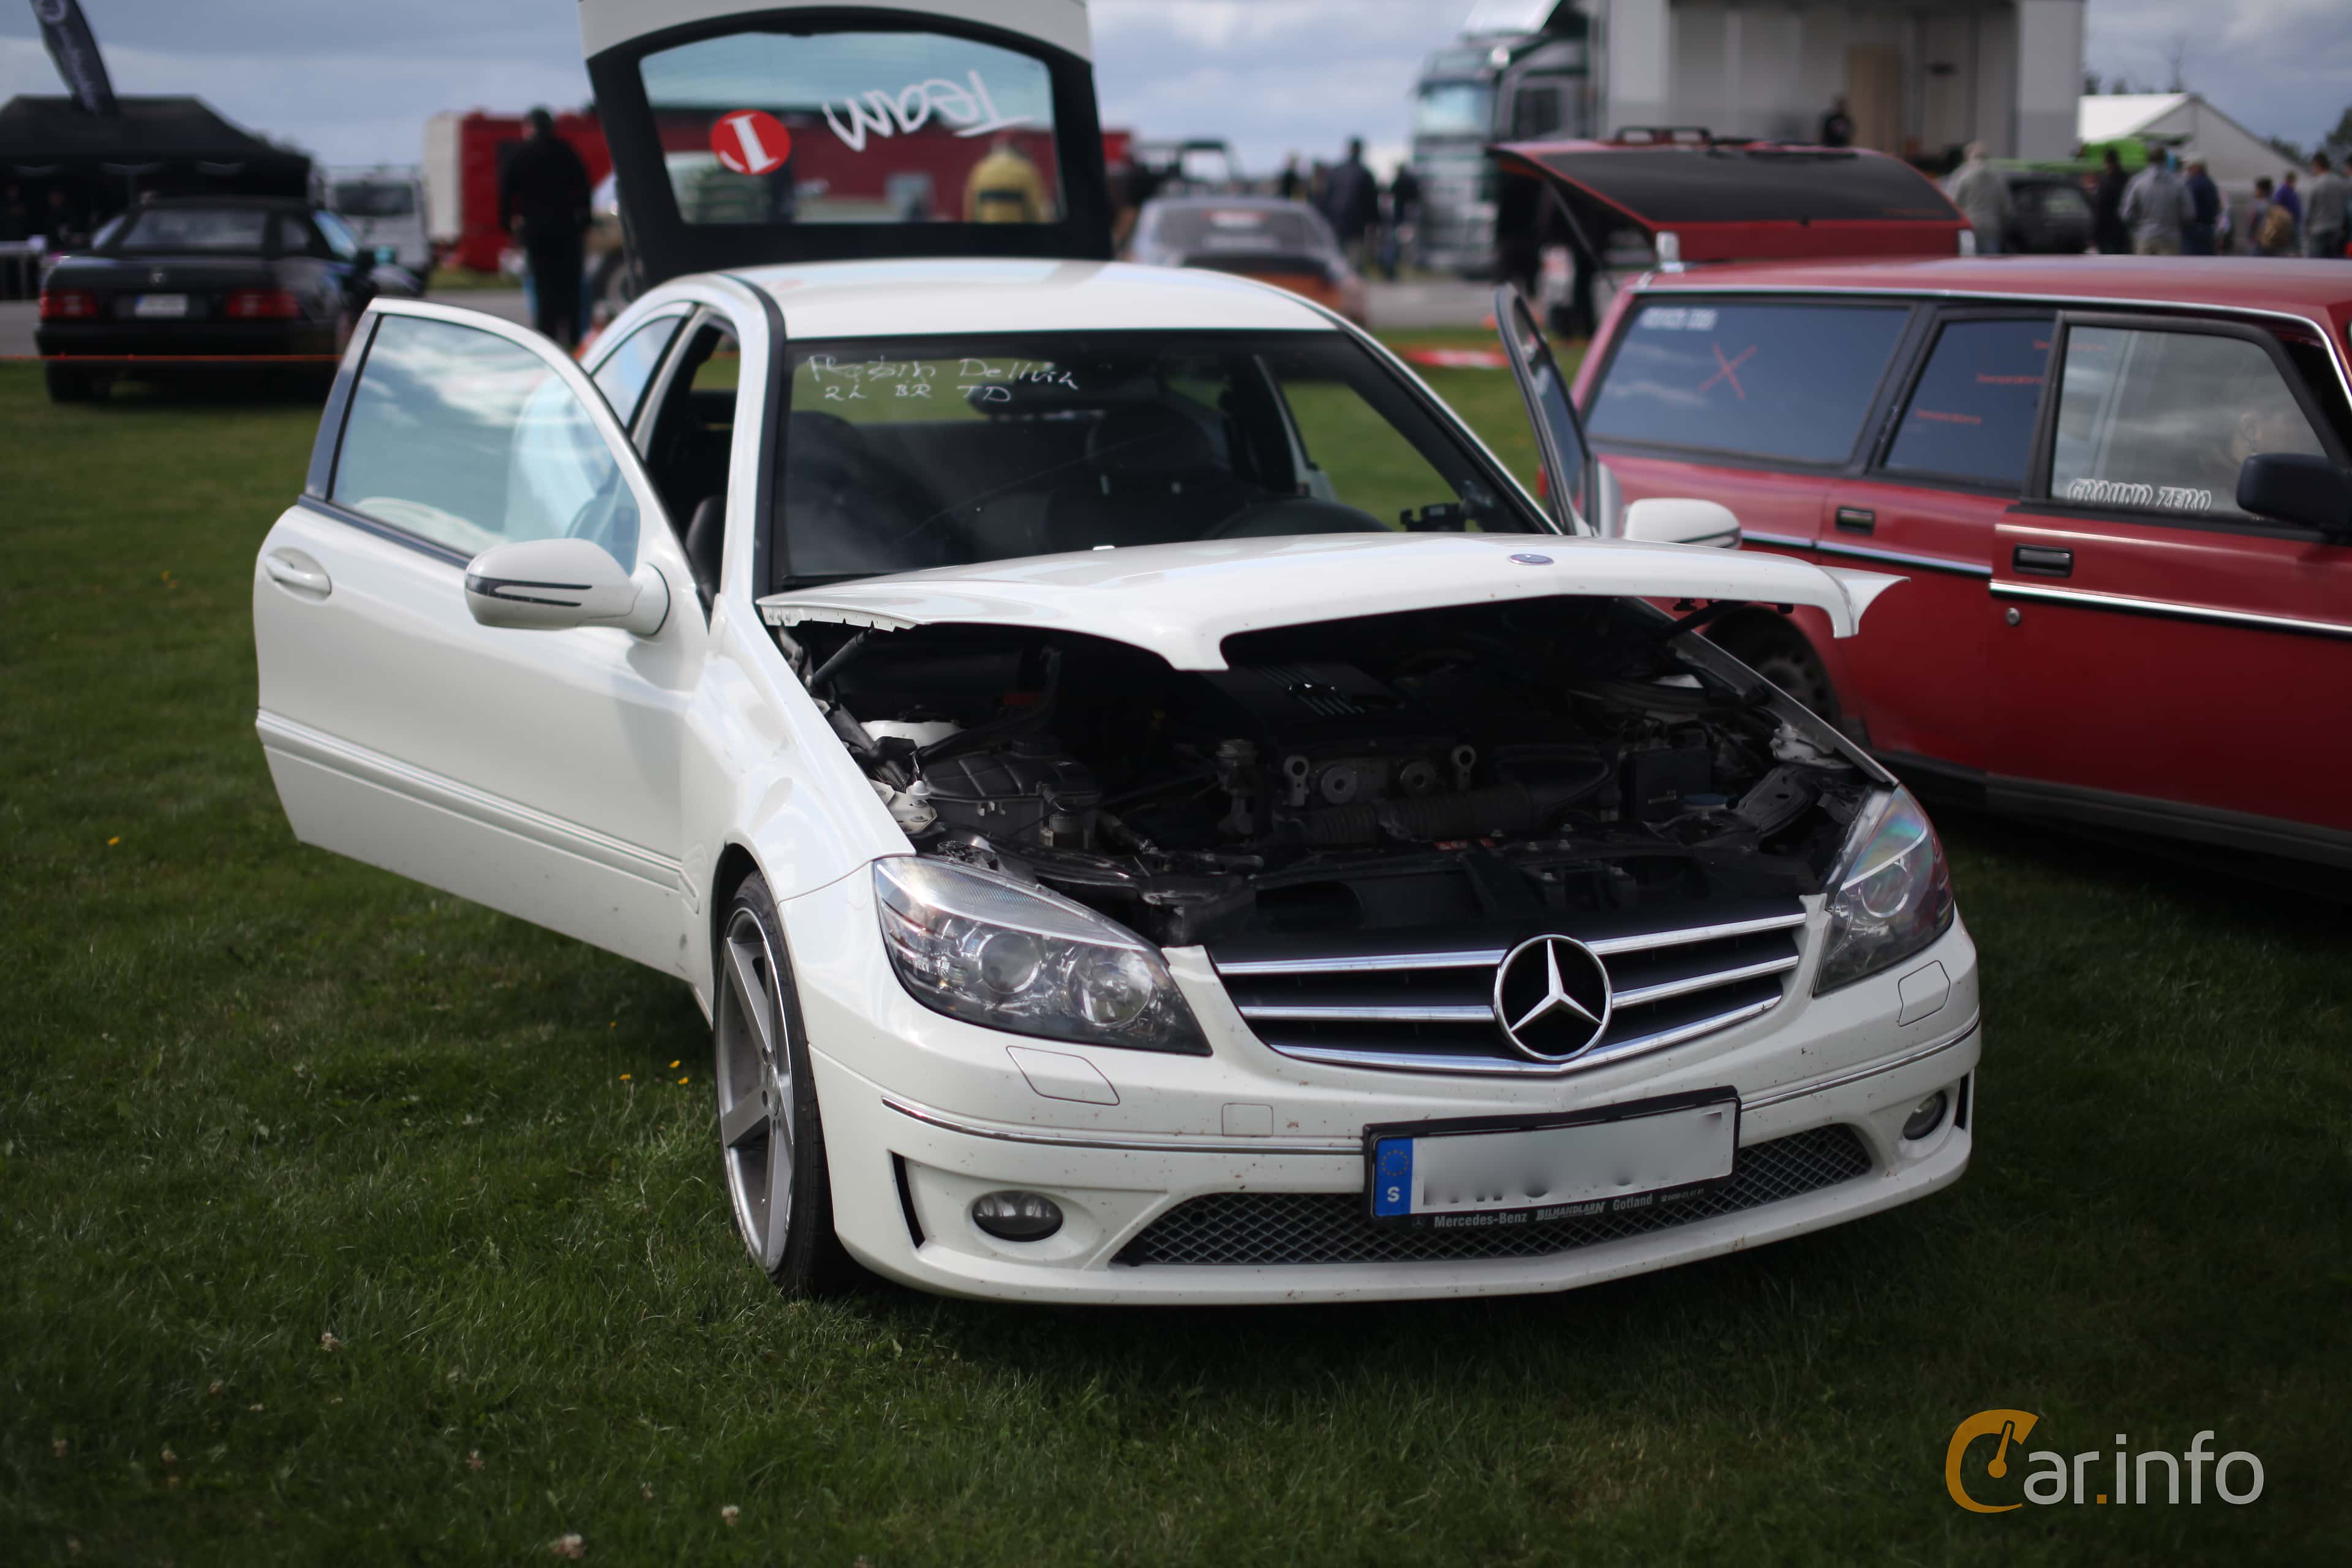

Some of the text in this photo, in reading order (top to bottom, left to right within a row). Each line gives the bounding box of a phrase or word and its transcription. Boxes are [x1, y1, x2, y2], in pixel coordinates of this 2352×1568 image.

[821, 69, 1036, 151] Team
[1387, 1186, 1400, 1203] S
[1433, 1212, 1528, 1229] Mercedes-Benz
[1612, 1194, 1653, 1211] Gotland
